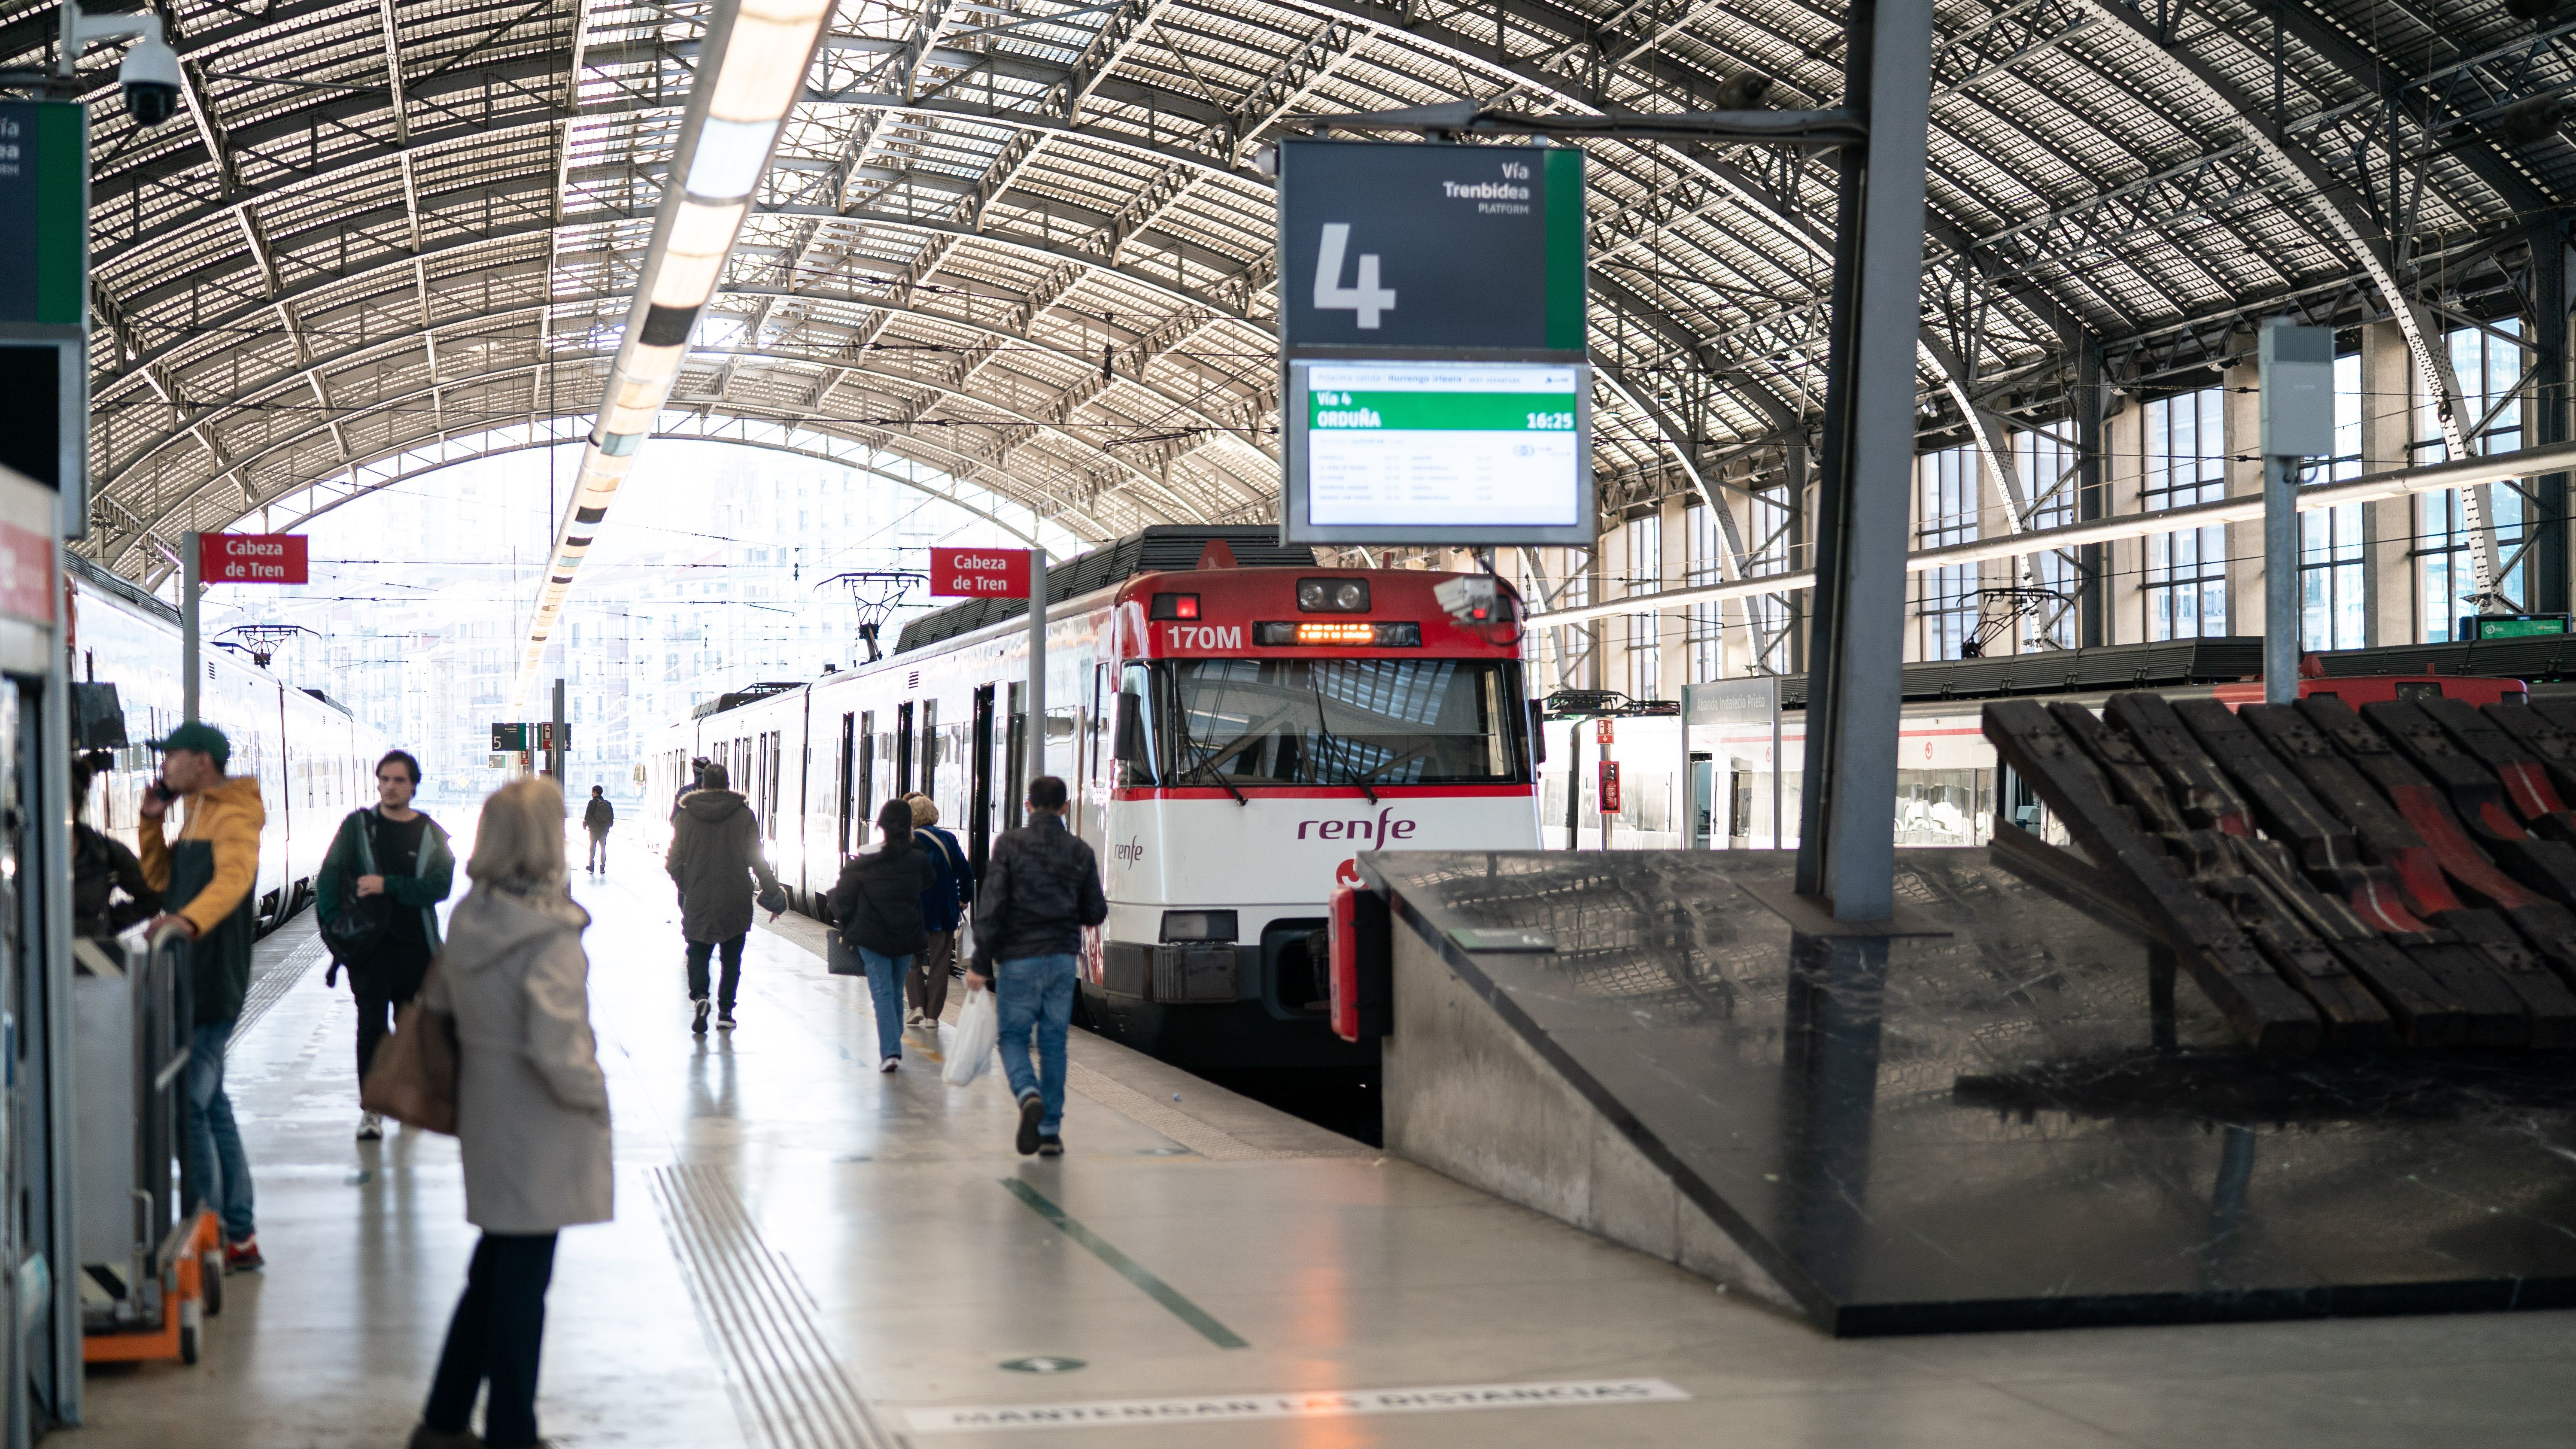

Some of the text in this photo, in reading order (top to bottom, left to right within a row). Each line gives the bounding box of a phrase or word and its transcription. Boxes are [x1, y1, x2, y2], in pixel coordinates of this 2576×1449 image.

[0, 117, 20, 137] ía
[1502, 161, 1530, 180] Vía
[1443, 180, 1530, 200] Trenbidea
[1478, 202, 1530, 215] PLATFORM
[1313, 222, 1397, 329] 4
[1388, 374, 1429, 383] Hurrengo
[1317, 391, 1352, 406] Vía 4
[1317, 407, 1382, 428] ORDUÑA
[1527, 412, 1574, 429] 16:25
[226, 540, 283, 555] Cabeza
[225, 561, 284, 577] de Tren
[954, 555, 1006, 570] Cabeza
[953, 575, 1007, 591] de Tren
[1168, 626, 1241, 649] 170M
[1697, 693, 1765, 711] Abando Indalecio Prieto
[494, 736, 501, 749] 5
[489, 760, 494, 768] 5
[1297, 807, 1416, 852] renfe
[1114, 835, 1143, 870] renfe
[953, 1383, 1650, 1425] MANTENGAN LAS DISTANCIAS
